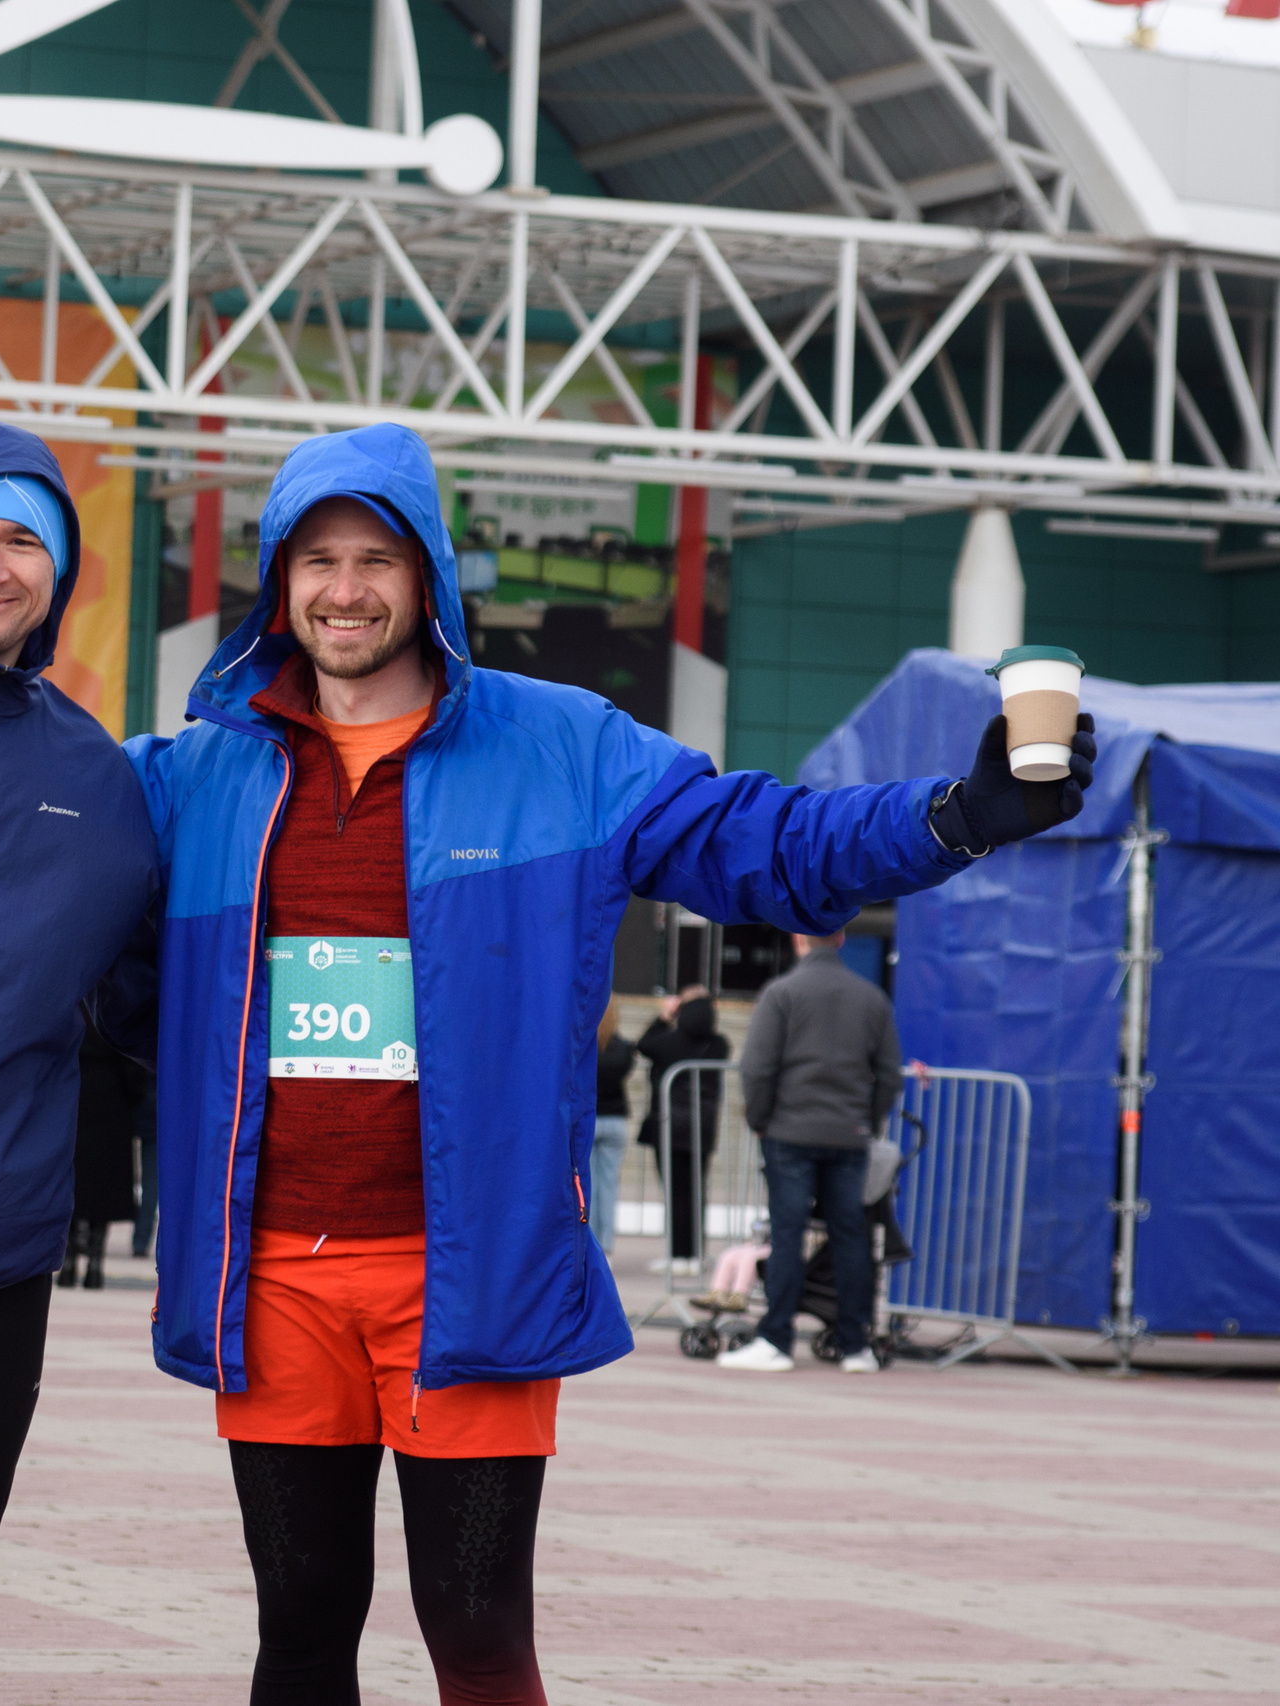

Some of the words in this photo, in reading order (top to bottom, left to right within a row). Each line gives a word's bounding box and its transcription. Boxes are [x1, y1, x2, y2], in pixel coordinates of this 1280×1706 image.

[48, 807, 80, 817] DEMIX
[451, 849, 499, 859] INOVIK
[273, 952, 294, 960] АСТРУМ
[287, 1003, 371, 1042] 390
[390, 1048, 407, 1060] 10
